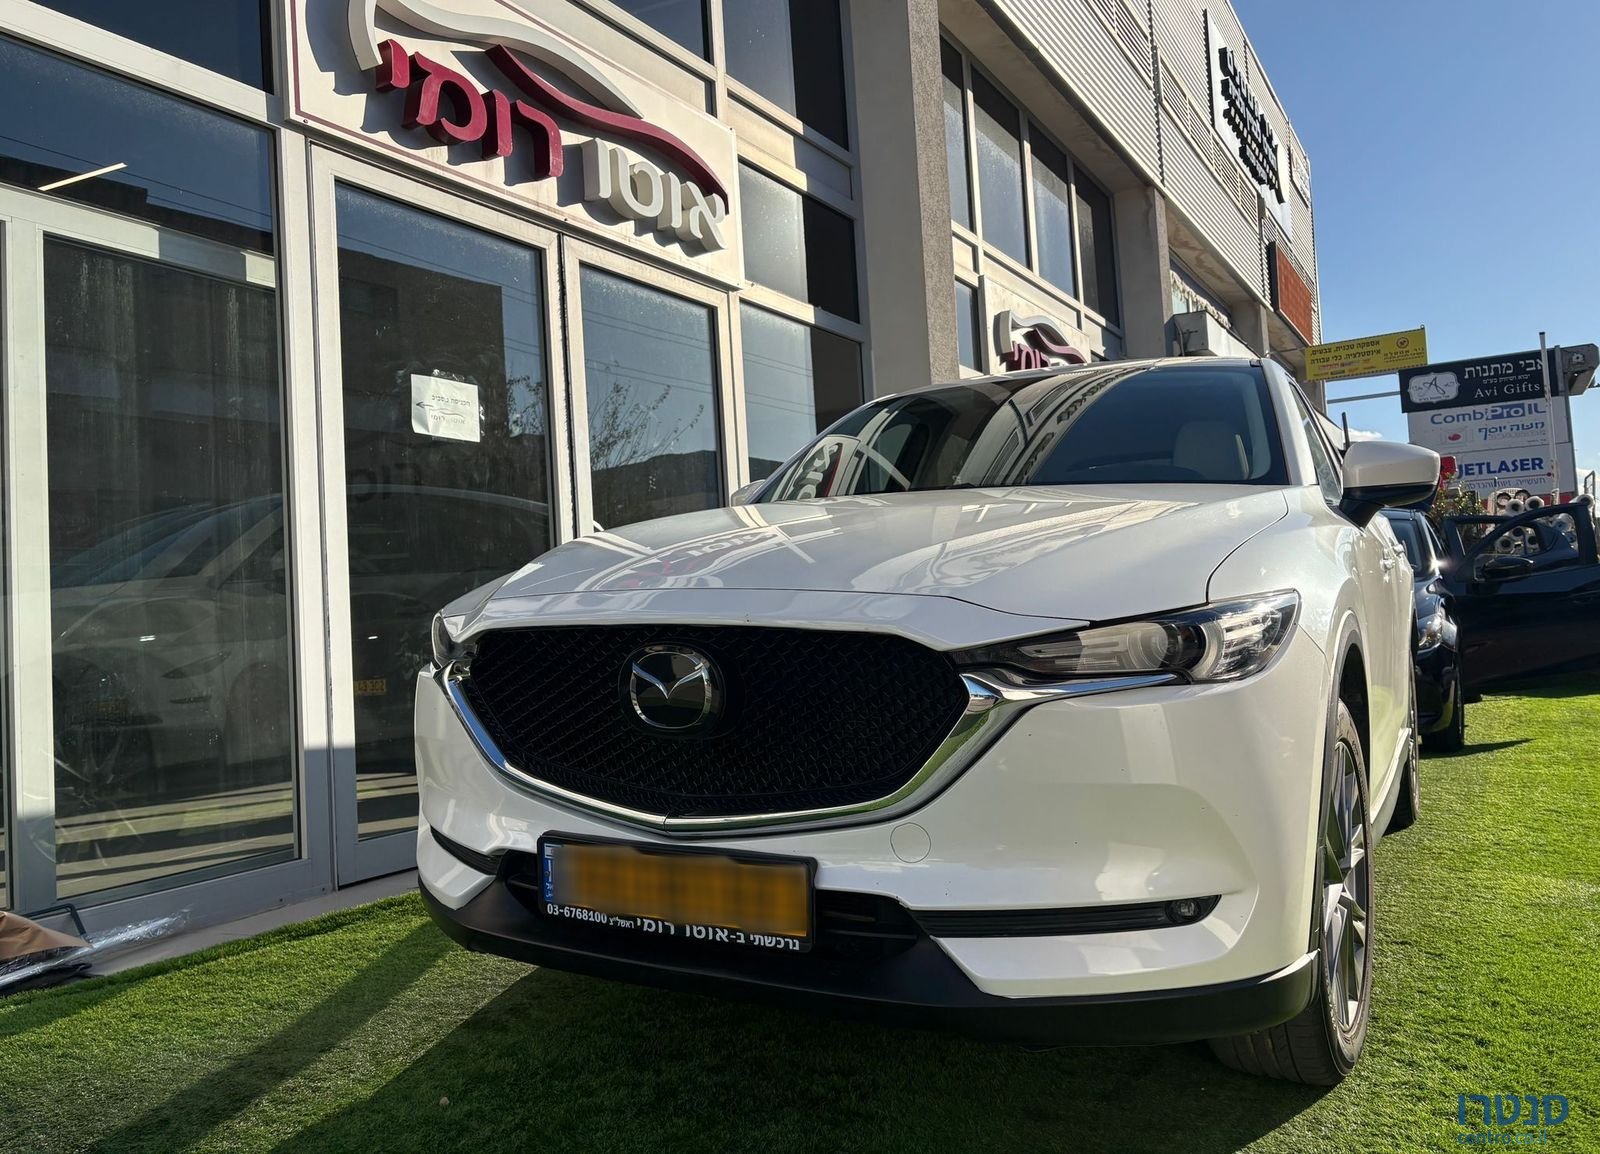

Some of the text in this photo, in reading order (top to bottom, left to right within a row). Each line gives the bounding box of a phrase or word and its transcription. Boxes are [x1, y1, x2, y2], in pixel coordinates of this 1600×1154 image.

[375, 39, 726, 252] אוטו רומי
[1464, 363, 1514, 379] מתנות
[1474, 381, 1541, 398] Avi Gifts
[1457, 457, 1544, 479] JETLASER
[546, 903, 608, 924] 03-6768100
[636, 917, 676, 936] רומי
[749, 933, 800, 951] נרכשתי
